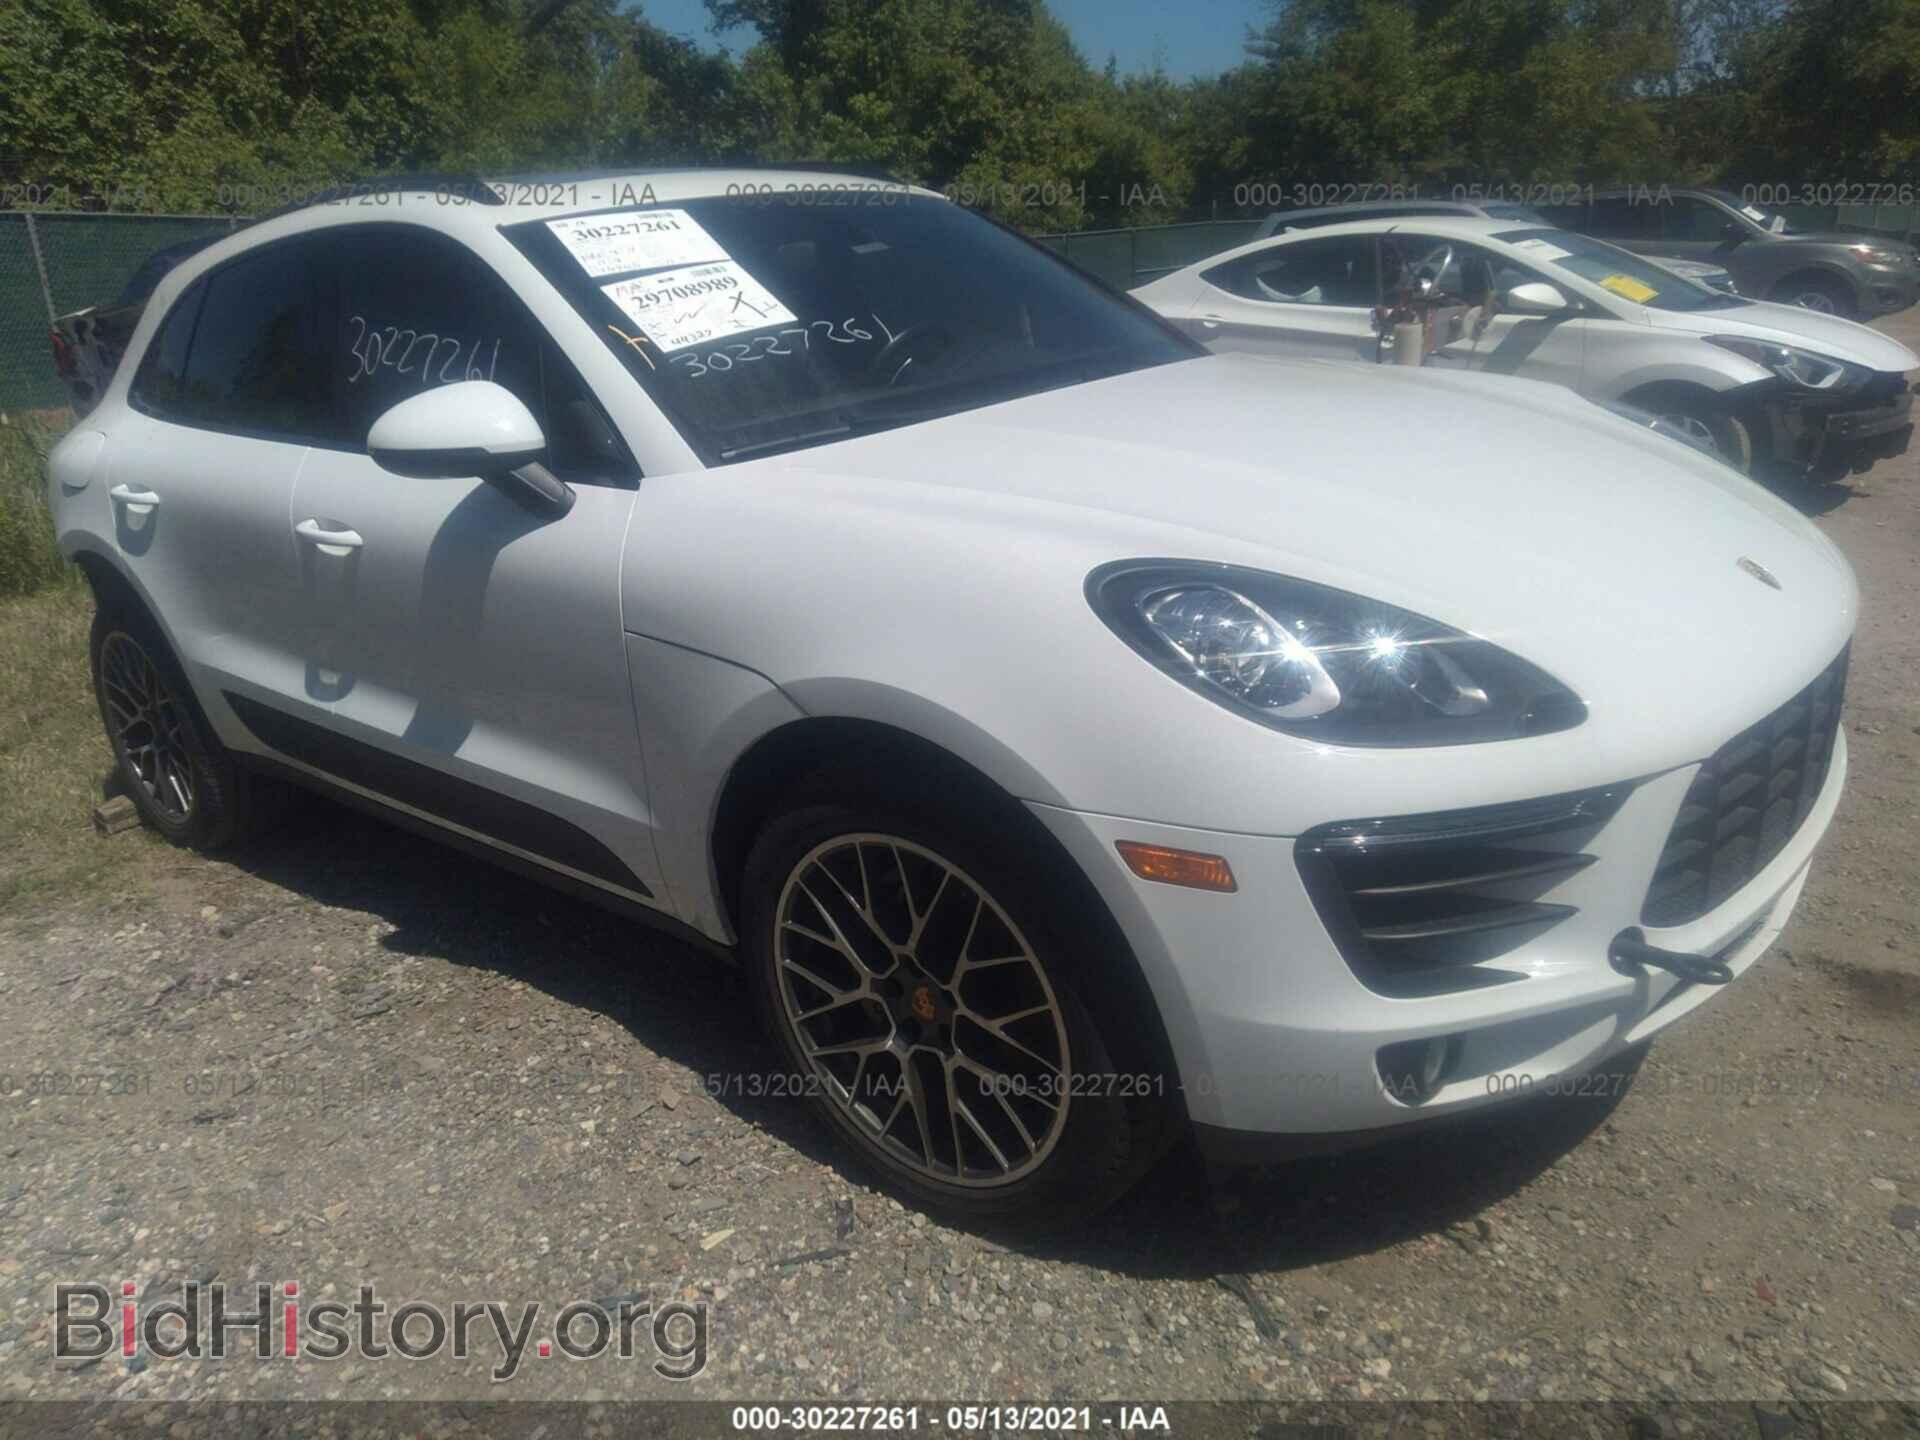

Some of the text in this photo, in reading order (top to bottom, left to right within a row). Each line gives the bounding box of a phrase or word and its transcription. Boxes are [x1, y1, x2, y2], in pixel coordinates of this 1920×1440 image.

[572, 219, 681, 241] 30227261
[632, 275, 739, 309] 29708989
[348, 316, 501, 383] 30227261
[669, 313, 896, 377] 30227261
